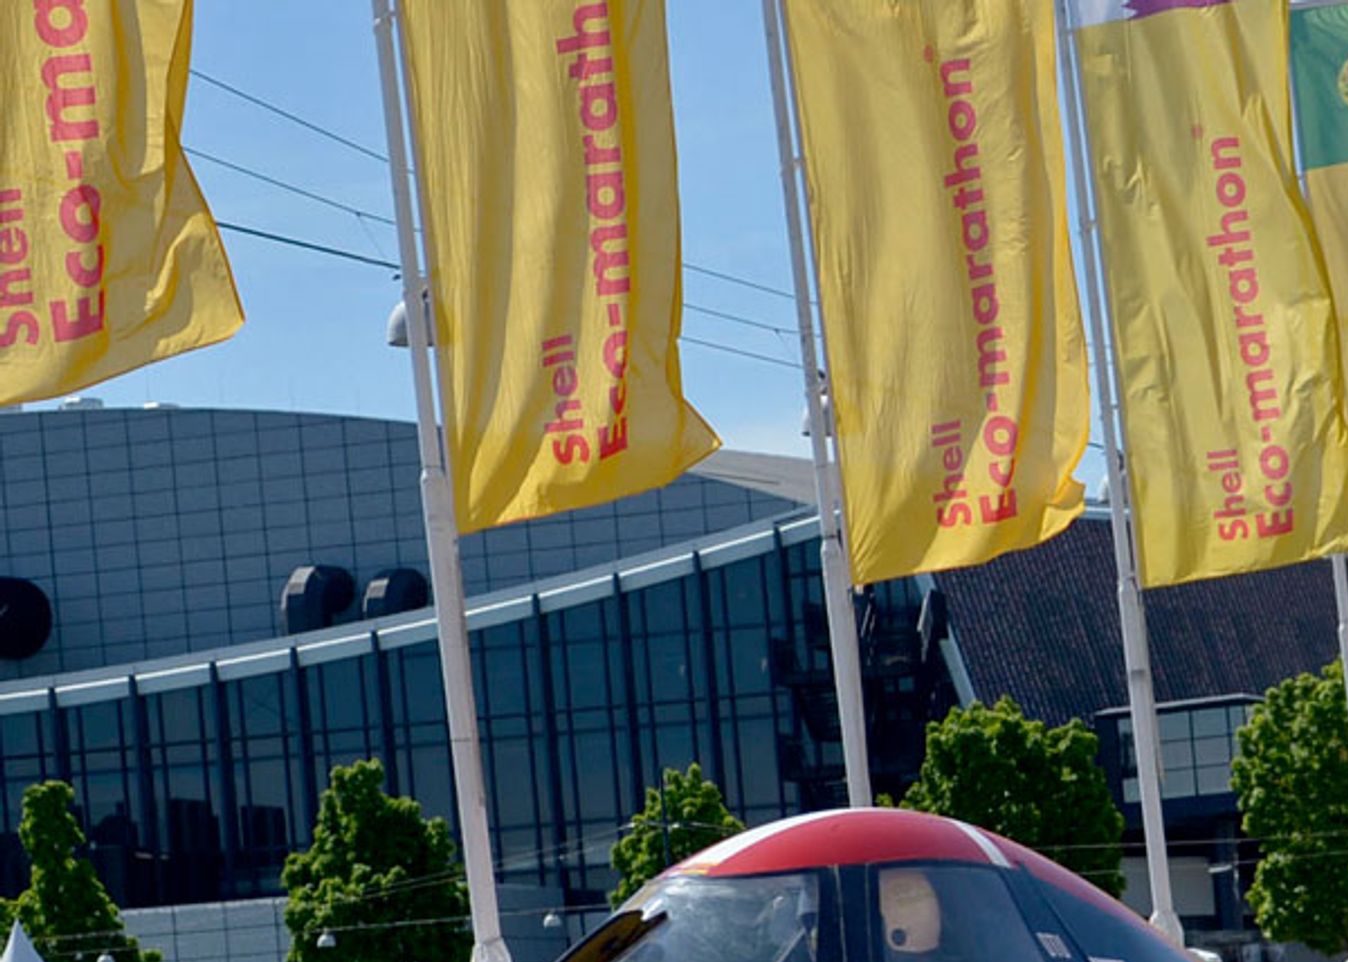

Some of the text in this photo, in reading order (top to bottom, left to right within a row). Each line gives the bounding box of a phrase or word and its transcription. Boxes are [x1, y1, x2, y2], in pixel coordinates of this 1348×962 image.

[939, 57, 1019, 526] Eco-marathon
[1206, 135, 1295, 540] Eco-marathon
[541, 333, 590, 465] Shell
[931, 419, 972, 528] Shell
[1206, 448, 1250, 542] Shell
